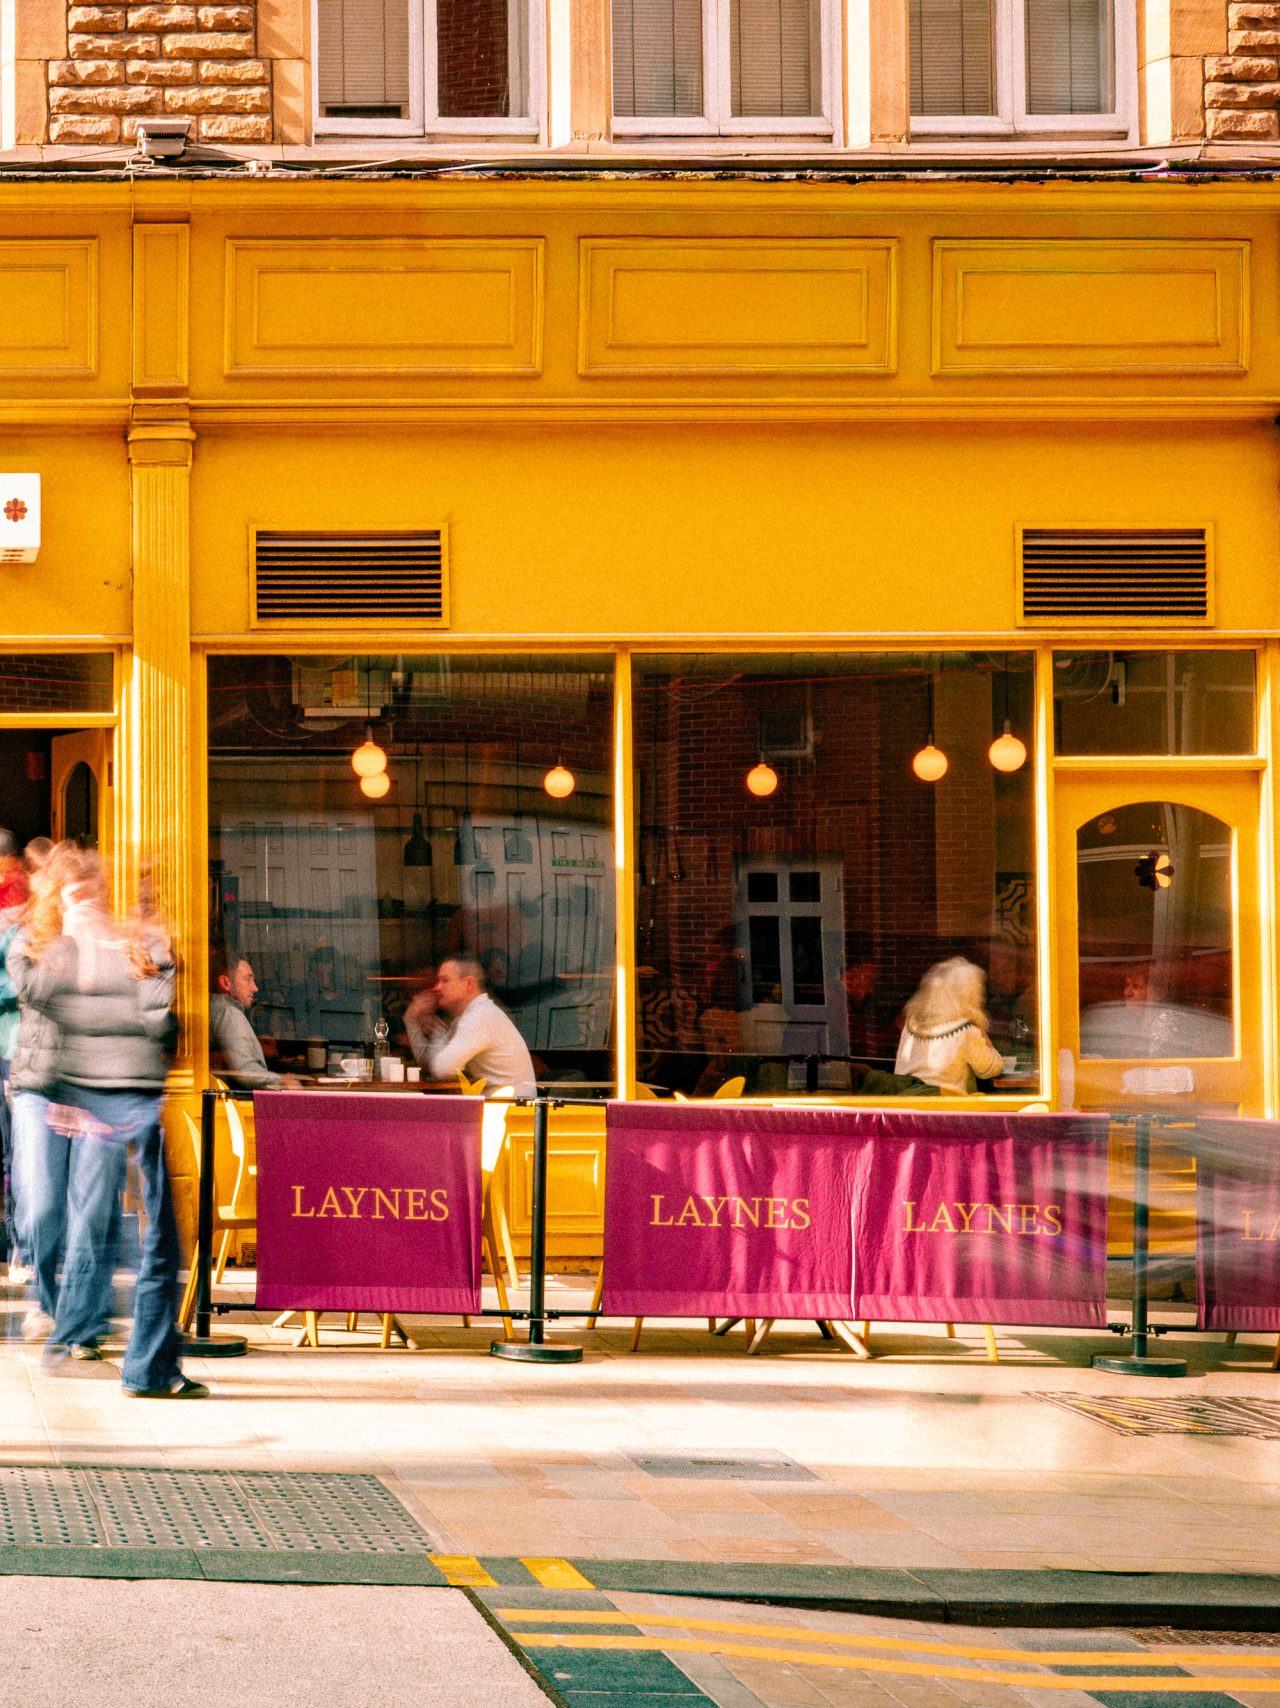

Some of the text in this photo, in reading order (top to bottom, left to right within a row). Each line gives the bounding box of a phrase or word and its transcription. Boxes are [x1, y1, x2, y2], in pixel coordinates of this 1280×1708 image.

[291, 1186, 449, 1222] LAYNES
[650, 1194, 1063, 1237] LAYNES LAYNES
